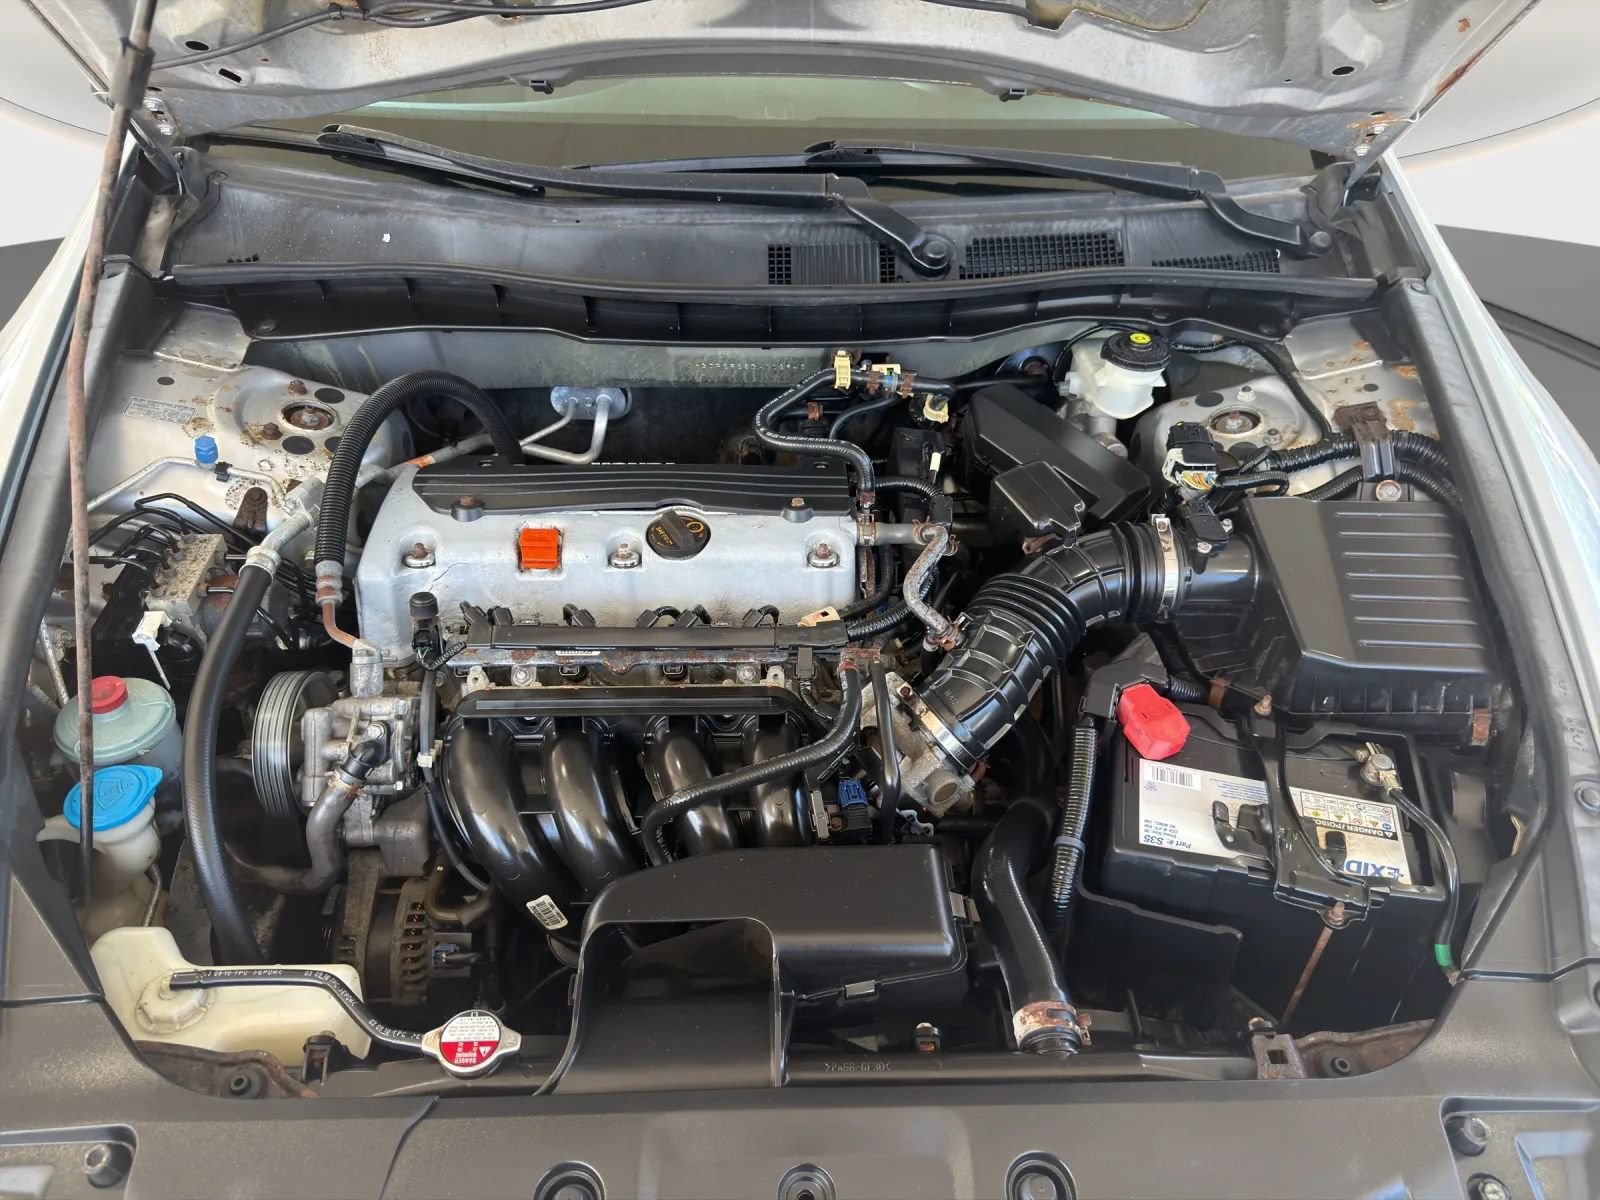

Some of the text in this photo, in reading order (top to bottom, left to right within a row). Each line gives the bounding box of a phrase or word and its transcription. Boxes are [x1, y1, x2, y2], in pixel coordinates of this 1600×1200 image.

[1312, 818, 1341, 828] POISO
[1346, 824, 1384, 837] DANGER
[1143, 834, 1164, 846] S35
[1175, 840, 1192, 849] Part
[1340, 859, 1403, 880] EXID
